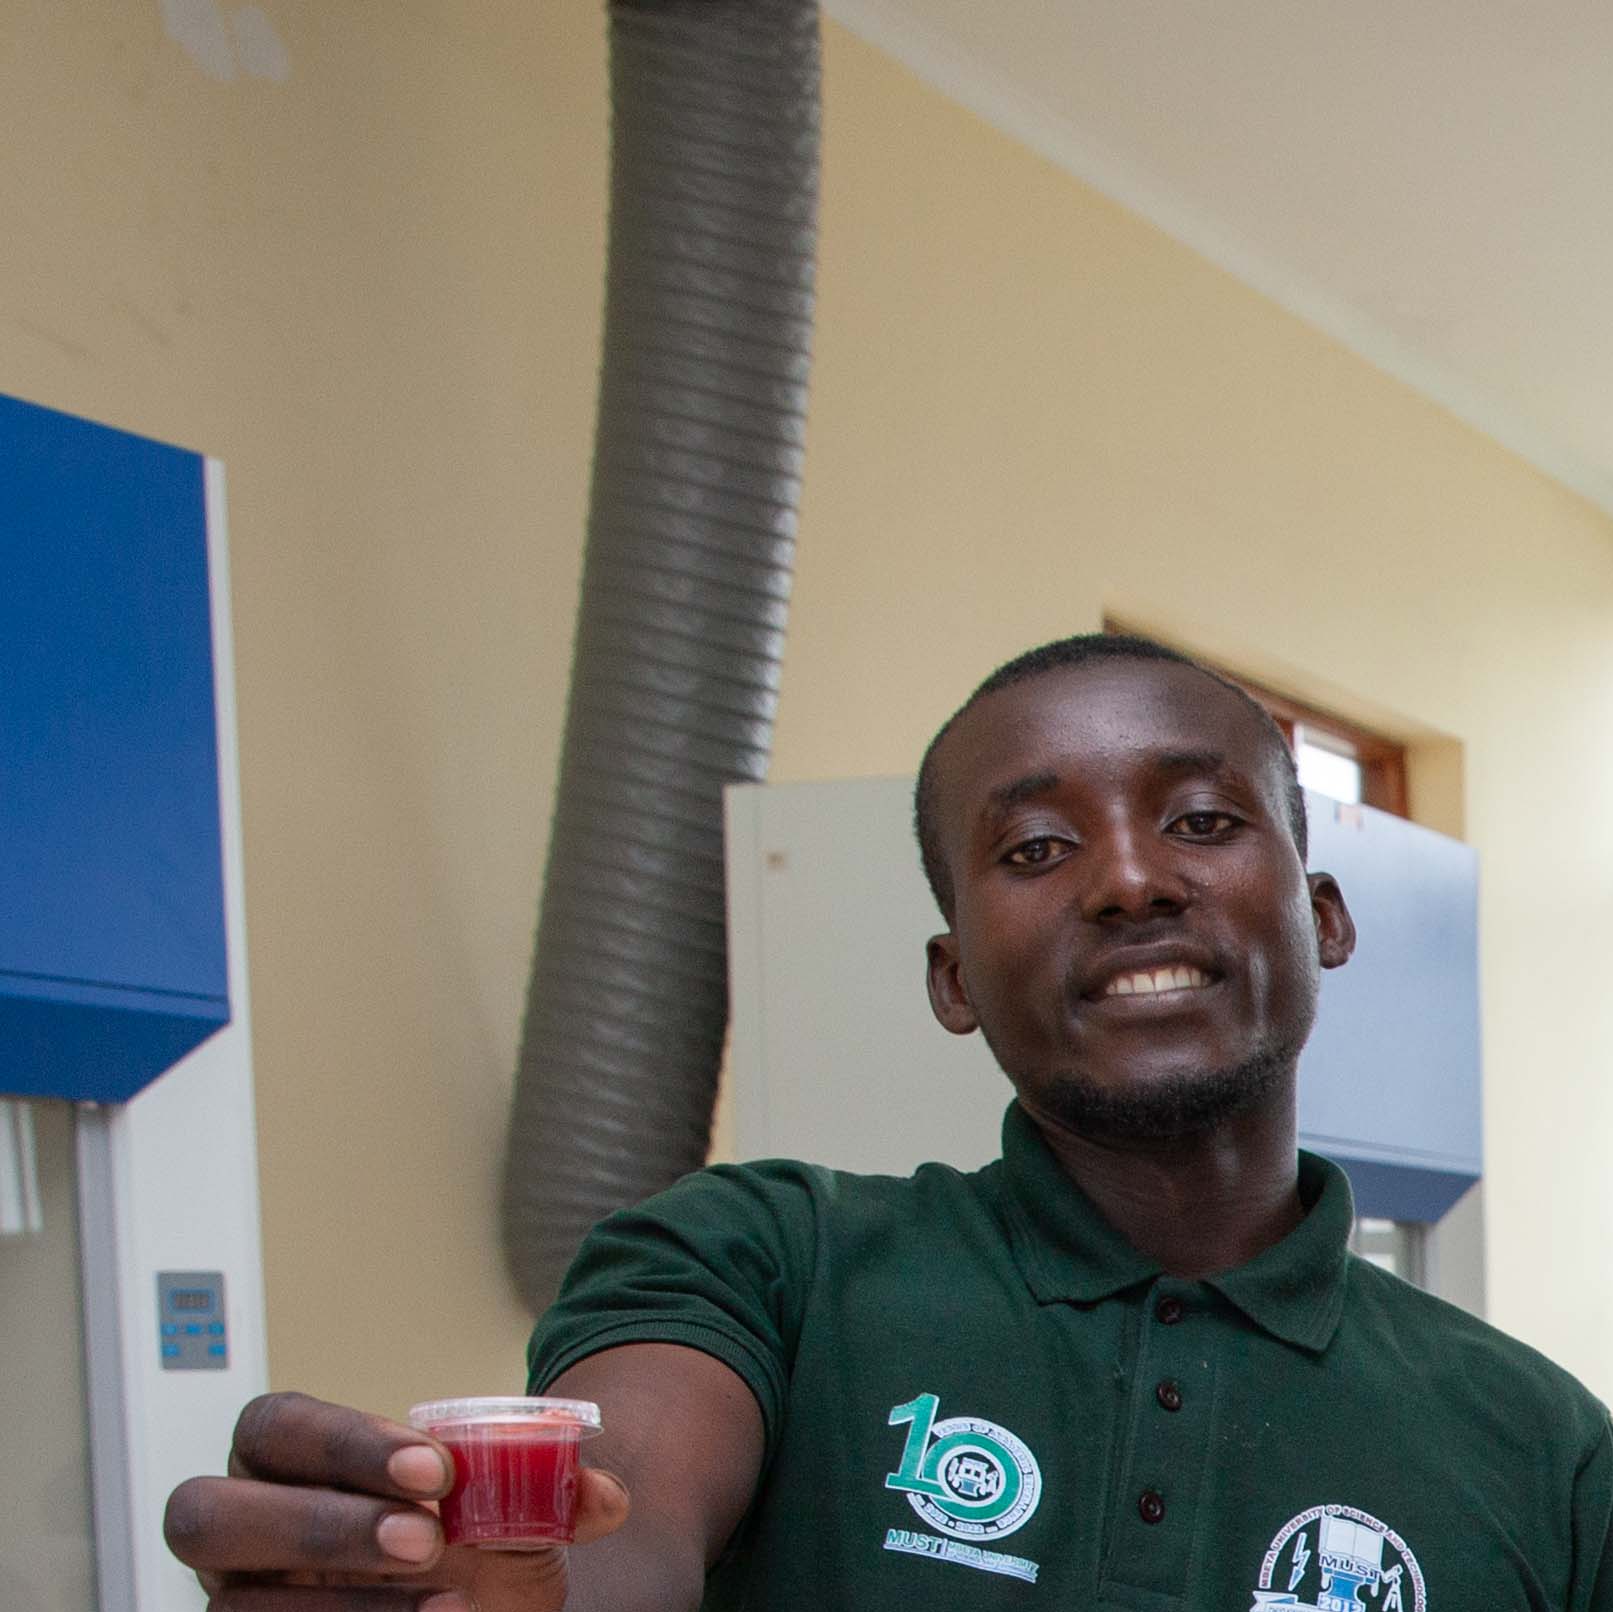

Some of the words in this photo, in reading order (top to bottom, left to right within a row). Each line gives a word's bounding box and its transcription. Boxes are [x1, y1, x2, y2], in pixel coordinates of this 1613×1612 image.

[1272, 1506, 1324, 1550] UNIVERSITY
[1326, 1505, 1341, 1516] OF
[1343, 1507, 1388, 1533] SCIENCE
[886, 1529, 942, 1553] MUST
[1320, 1554, 1381, 1580] MUST
